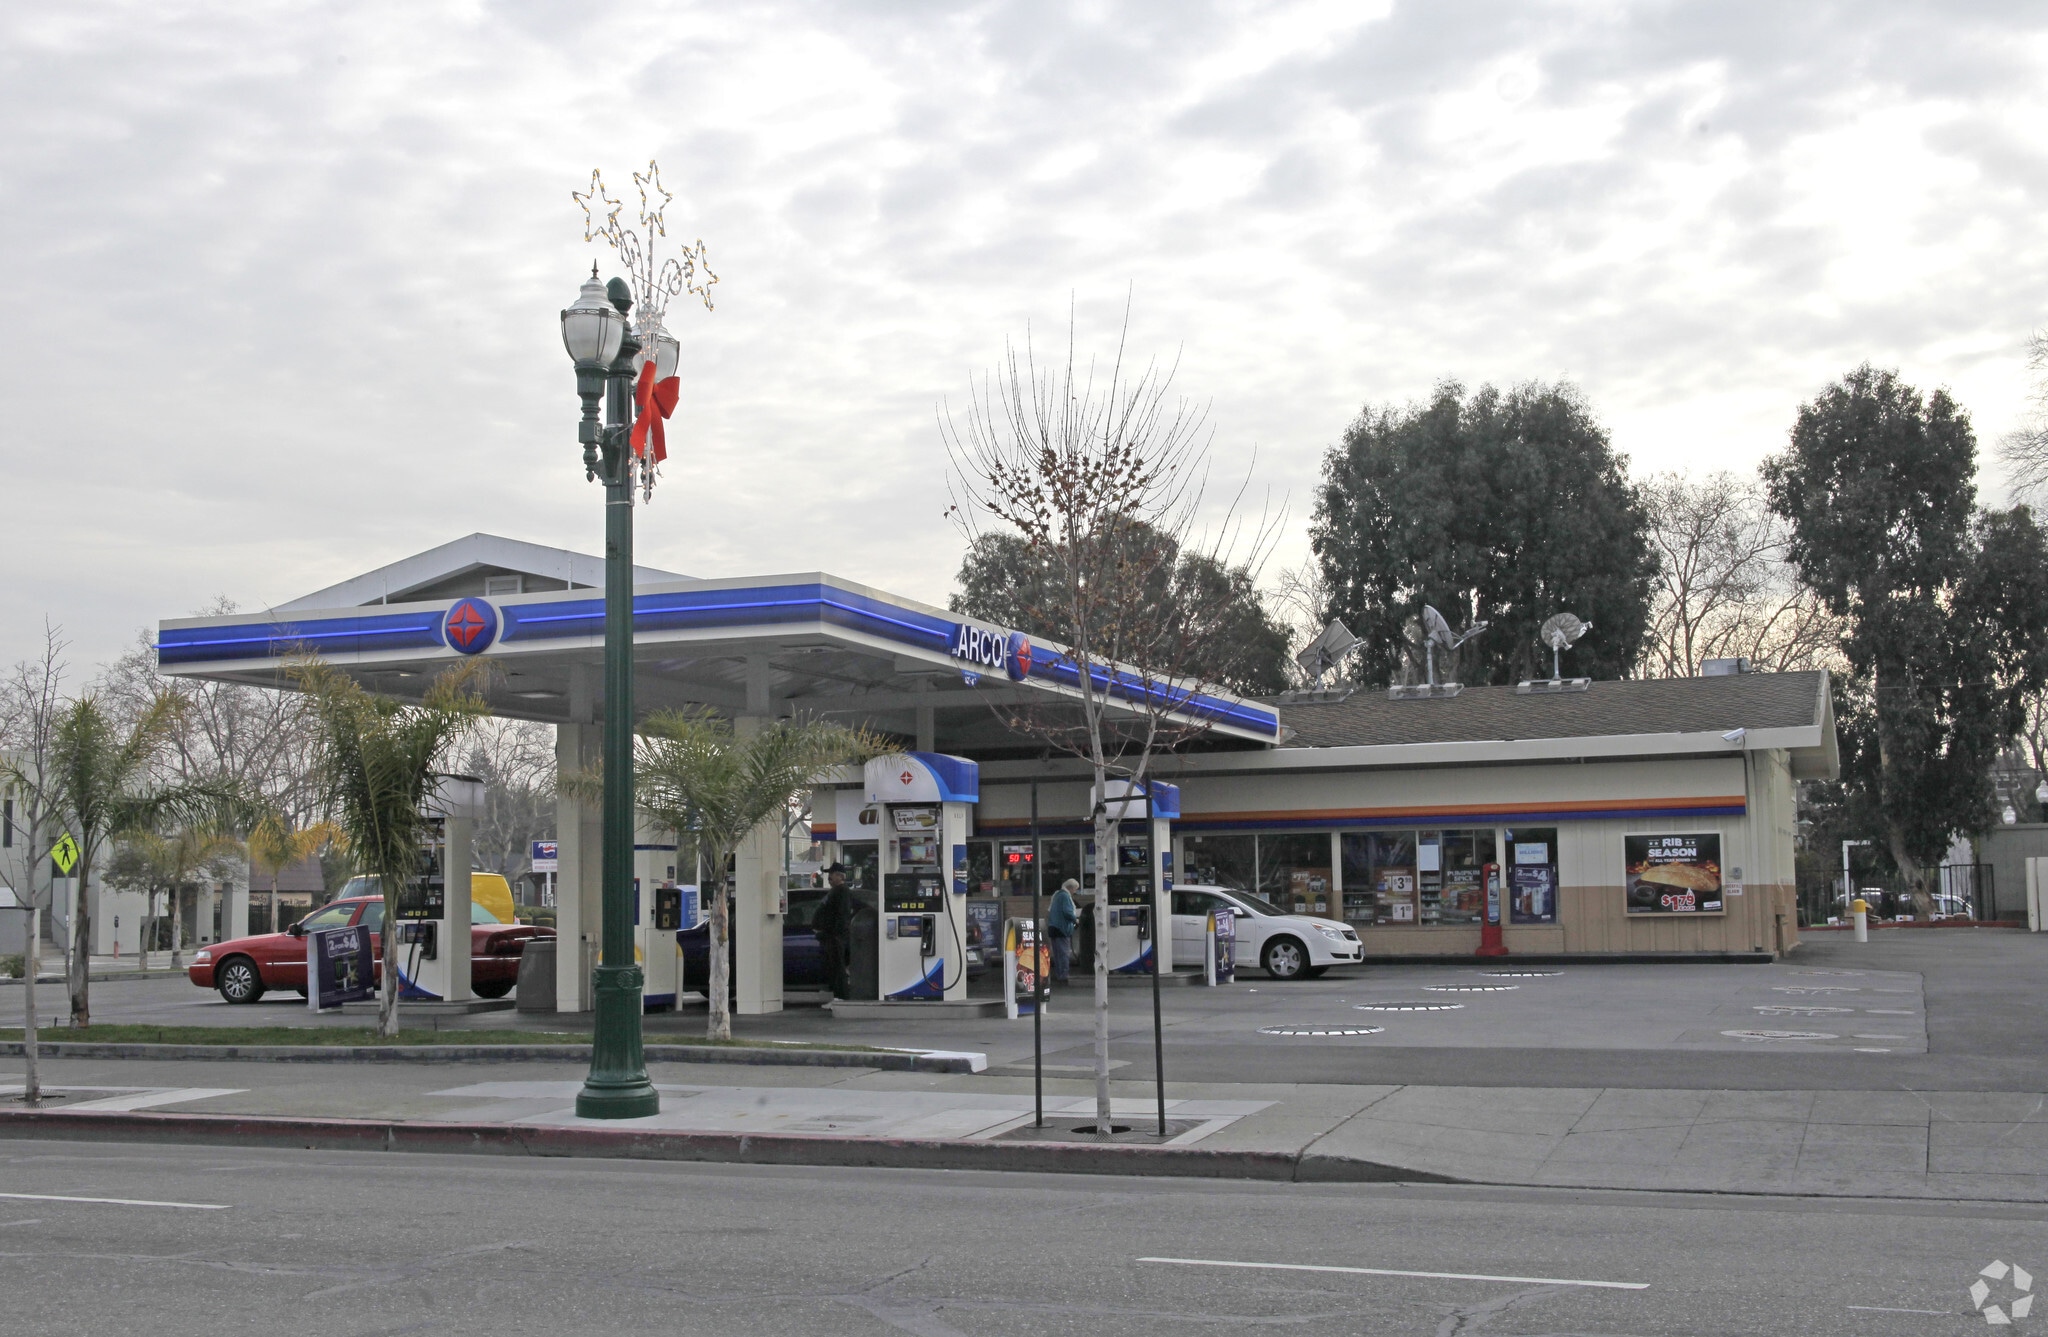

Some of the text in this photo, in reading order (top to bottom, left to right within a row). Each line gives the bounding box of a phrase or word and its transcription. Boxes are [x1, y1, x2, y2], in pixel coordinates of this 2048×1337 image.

[957, 624, 1003, 667] ARCO
[1662, 838, 1682, 847] RIB
[1009, 854, 1020, 862] 50
[1648, 848, 1697, 857] SEASON
[1517, 869, 1523, 877] 2
[1532, 869, 1548, 882] $4
[329, 940, 335, 950] 2
[343, 934, 358, 949] $4
